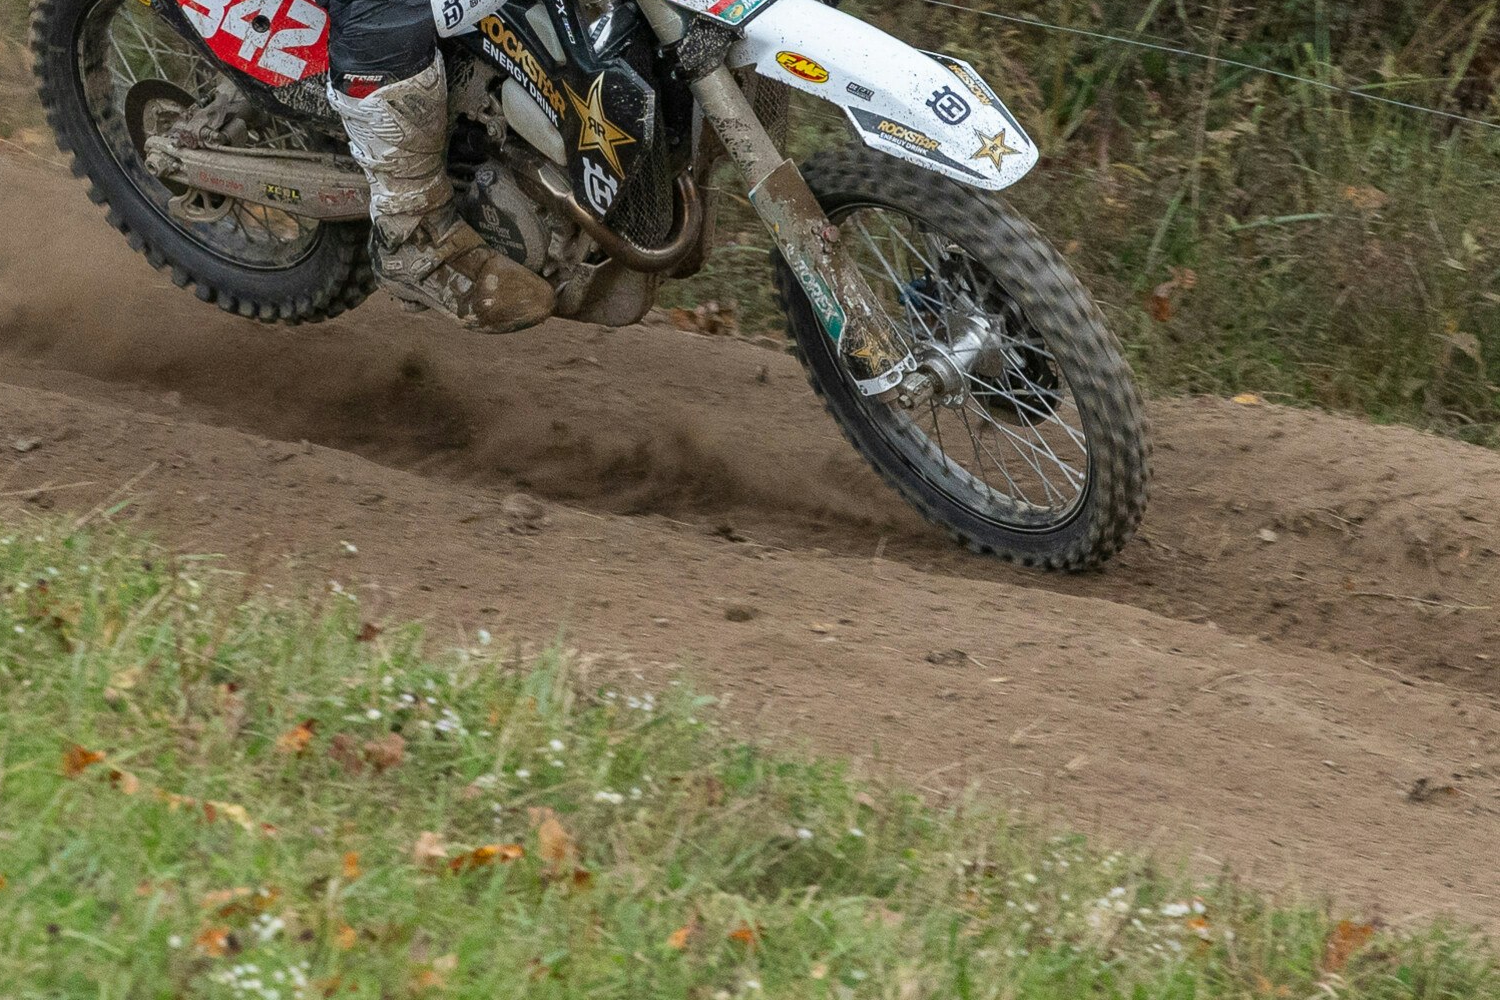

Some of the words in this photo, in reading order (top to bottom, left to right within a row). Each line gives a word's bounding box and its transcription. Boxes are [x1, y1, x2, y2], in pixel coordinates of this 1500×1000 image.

[776, 52, 830, 81] FMF
[483, 37, 528, 88] ENERGY
[529, 82, 558, 128] DRINK
[878, 120, 940, 151] ROCKSTAR
[905, 141, 928, 156] DRINK
